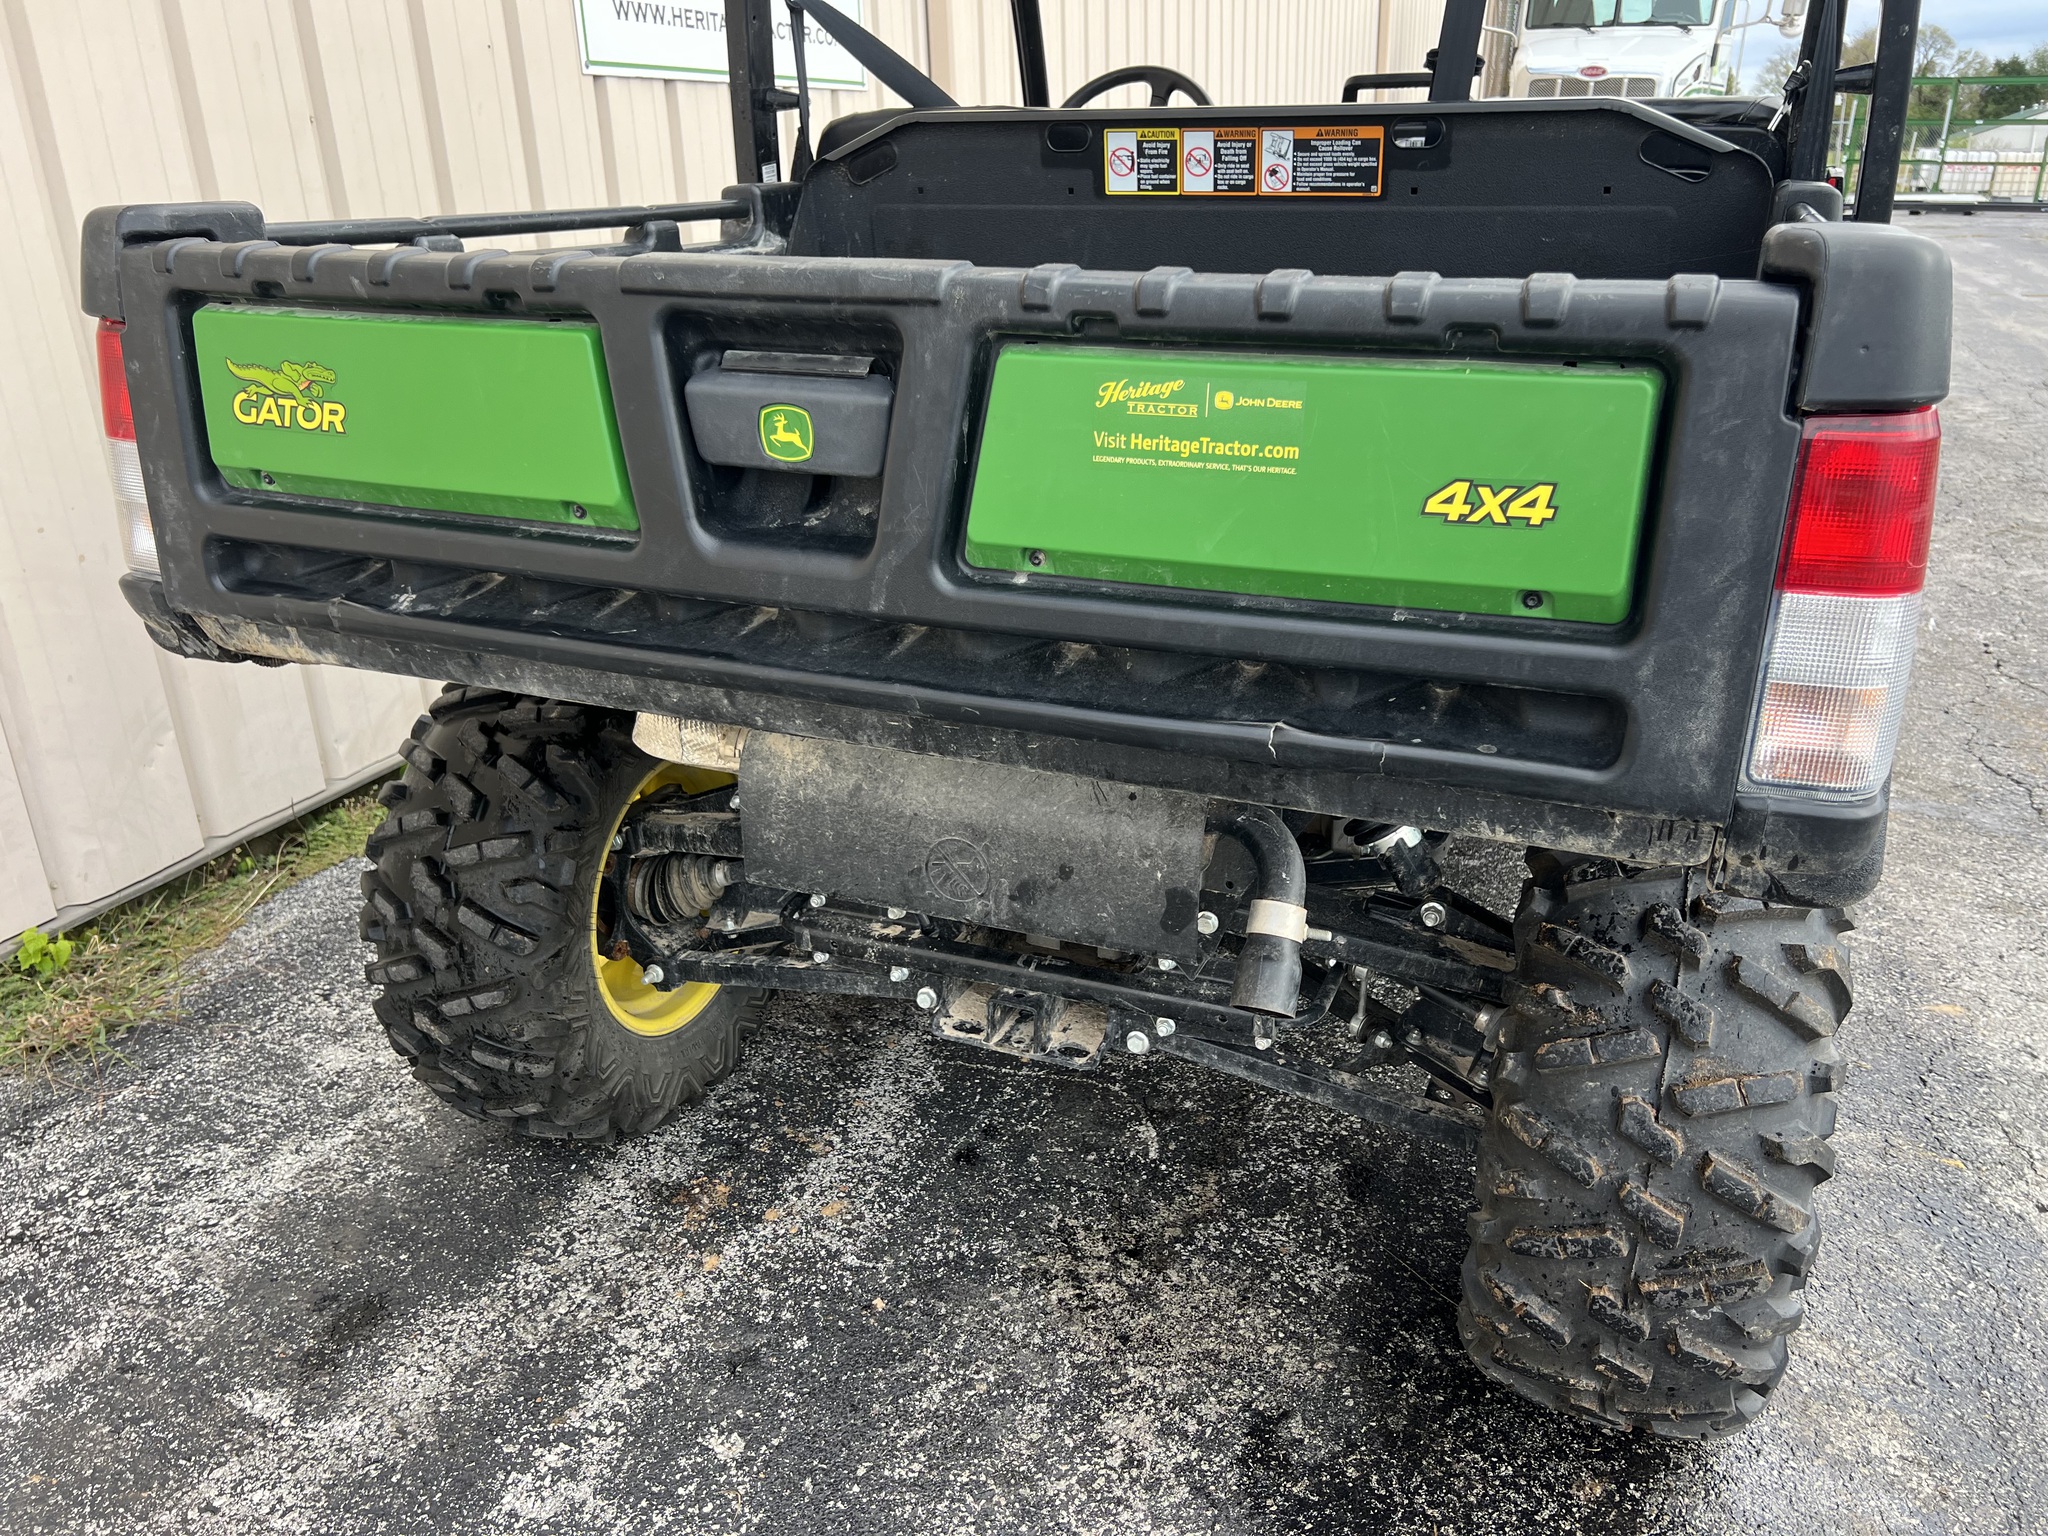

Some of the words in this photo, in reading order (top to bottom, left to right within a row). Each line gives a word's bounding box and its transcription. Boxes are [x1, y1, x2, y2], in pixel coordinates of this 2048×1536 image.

[1224, 130, 1256, 138] WARNING
[1324, 129, 1358, 137] WARNING
[1095, 378, 1185, 408] Heritage
[1127, 403, 1198, 416] TRACTOR
[1235, 396, 1265, 408] JOHN
[1266, 398, 1303, 409] DEERE
[232, 390, 347, 435] GATOR
[1093, 430, 1127, 449] Visit
[1130, 432, 1300, 460] HeritageTractor.com
[1092, 455, 1125, 464] LEGENDARY
[1125, 457, 1157, 467] PRODUCTS,
[1158, 459, 1205, 469] EXTRAORDINARY
[1232, 464, 1252, 472] THAT'S
[1252, 465, 1266, 473] OUR
[1266, 466, 1298, 475] HERITAGE.
